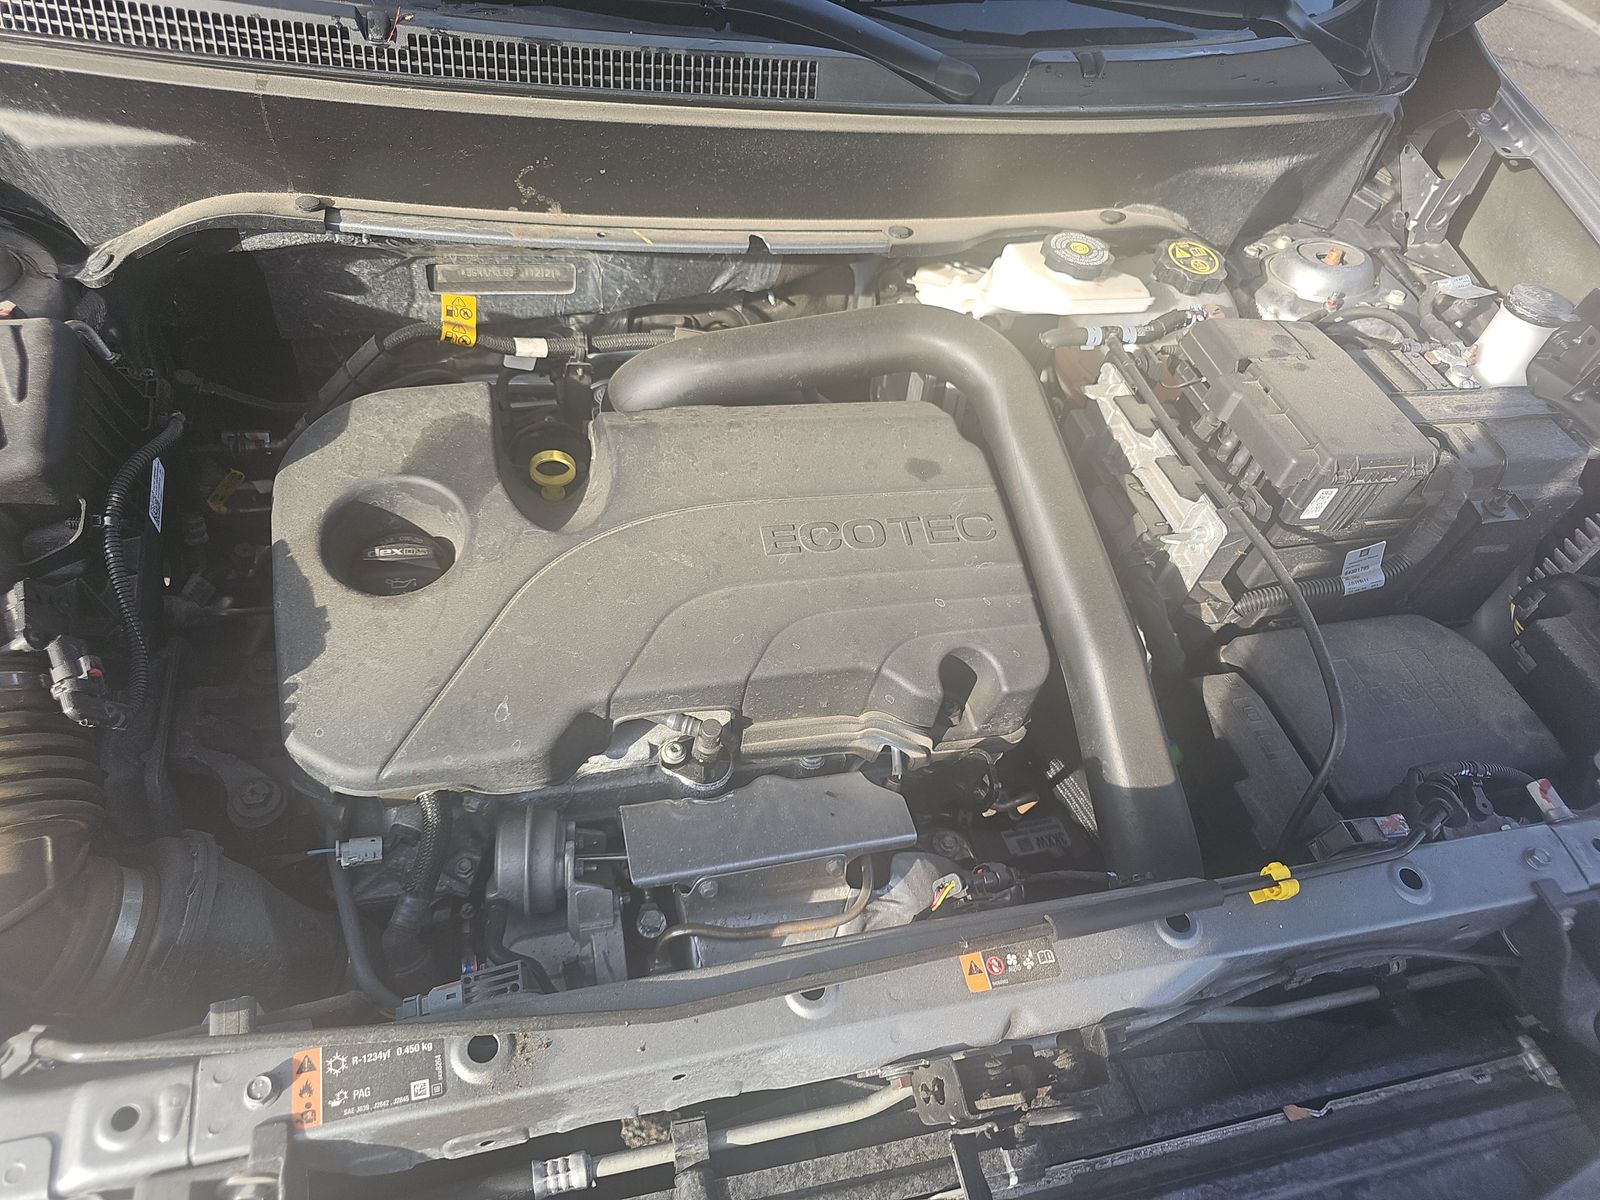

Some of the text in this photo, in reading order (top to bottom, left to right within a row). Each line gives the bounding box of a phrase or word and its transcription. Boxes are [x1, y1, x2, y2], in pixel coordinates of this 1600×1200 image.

[760, 512, 997, 556] ECOTEC
[352, 1041, 433, 1066] R-1234yf 0.450 kg
[353, 1086, 371, 1100] PAG
